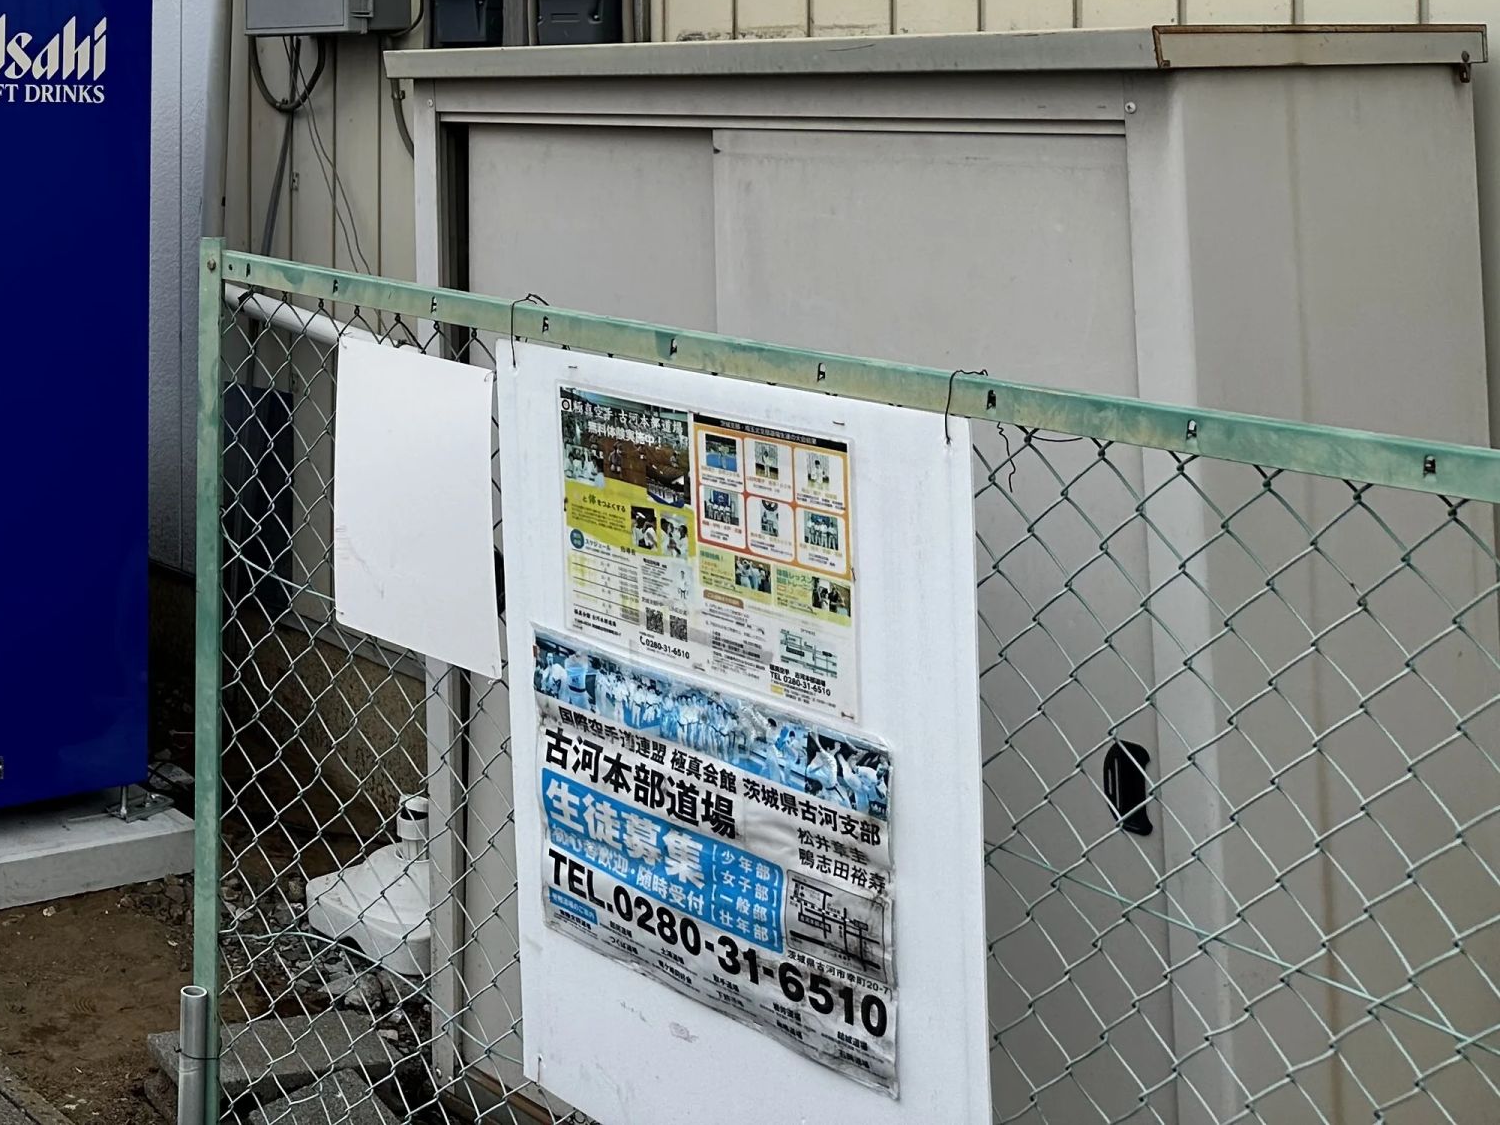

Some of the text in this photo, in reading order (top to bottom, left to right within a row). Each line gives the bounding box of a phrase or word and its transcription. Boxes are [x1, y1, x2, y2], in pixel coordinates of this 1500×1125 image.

[24, 85, 105, 103] DRINKS
[645, 639, 690, 660] 0280-31-6510
[770, 671, 782, 682] TEL
[783, 675, 831, 696] 0280-31-6510
[545, 727, 736, 840] 古河本部道場
[558, 706, 881, 846] 国際空手道連盟 極真会館 茨城県古河支部
[545, 779, 705, 889] 生徒募集
